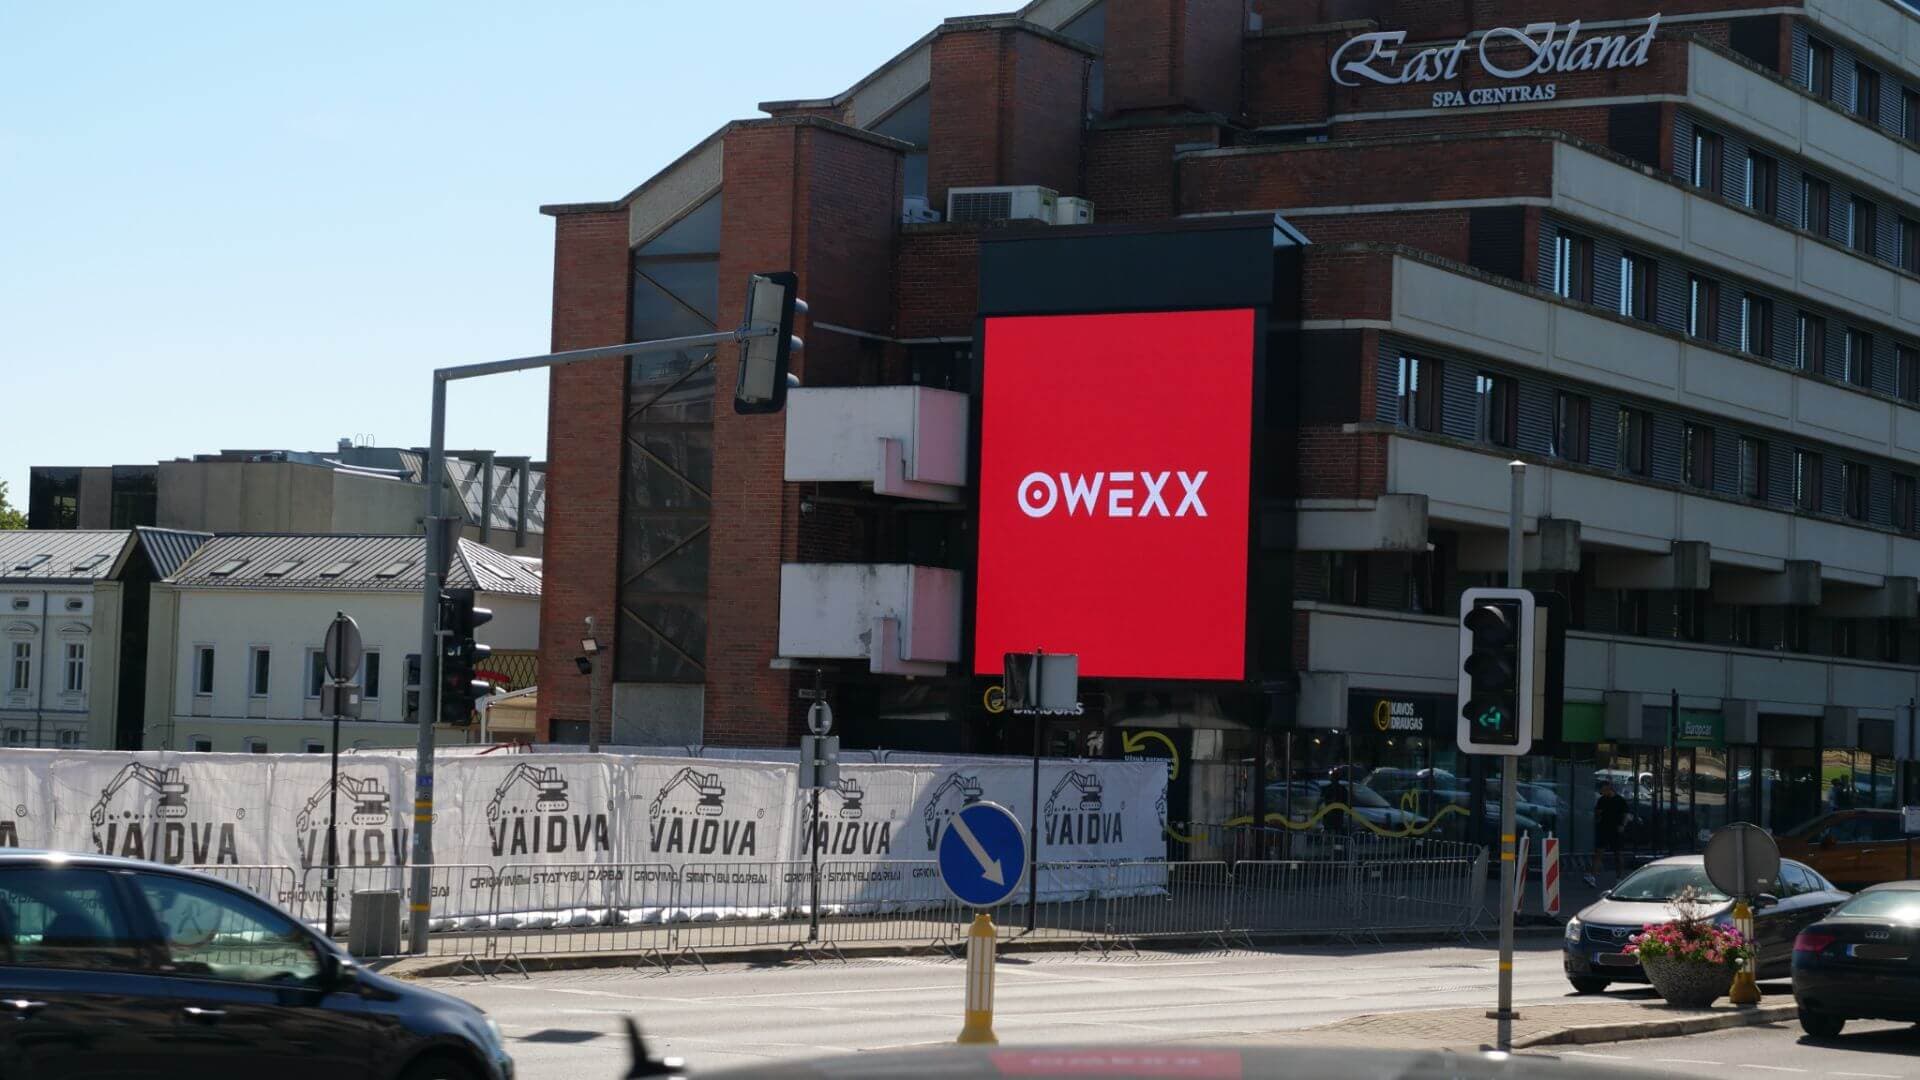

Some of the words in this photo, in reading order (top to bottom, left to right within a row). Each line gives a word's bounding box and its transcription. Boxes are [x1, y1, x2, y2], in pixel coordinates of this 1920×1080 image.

[1330, 30, 1470, 86] East
[1479, 12, 1661, 79] Island
[1432, 91, 1465, 107] SPA
[1469, 84, 1556, 105] CENTRAS
[1017, 471, 1208, 518] OWEXX
[1391, 702, 1414, 716] KAVOS
[1391, 717, 1423, 731] DRAUGAS
[92, 822, 239, 864] VAIDVA
[488, 814, 610, 856] VAIDVA
[650, 816, 756, 856] VAIDVA
[801, 820, 892, 855] VAIDVA
[1045, 812, 1123, 845] VAIDVA
